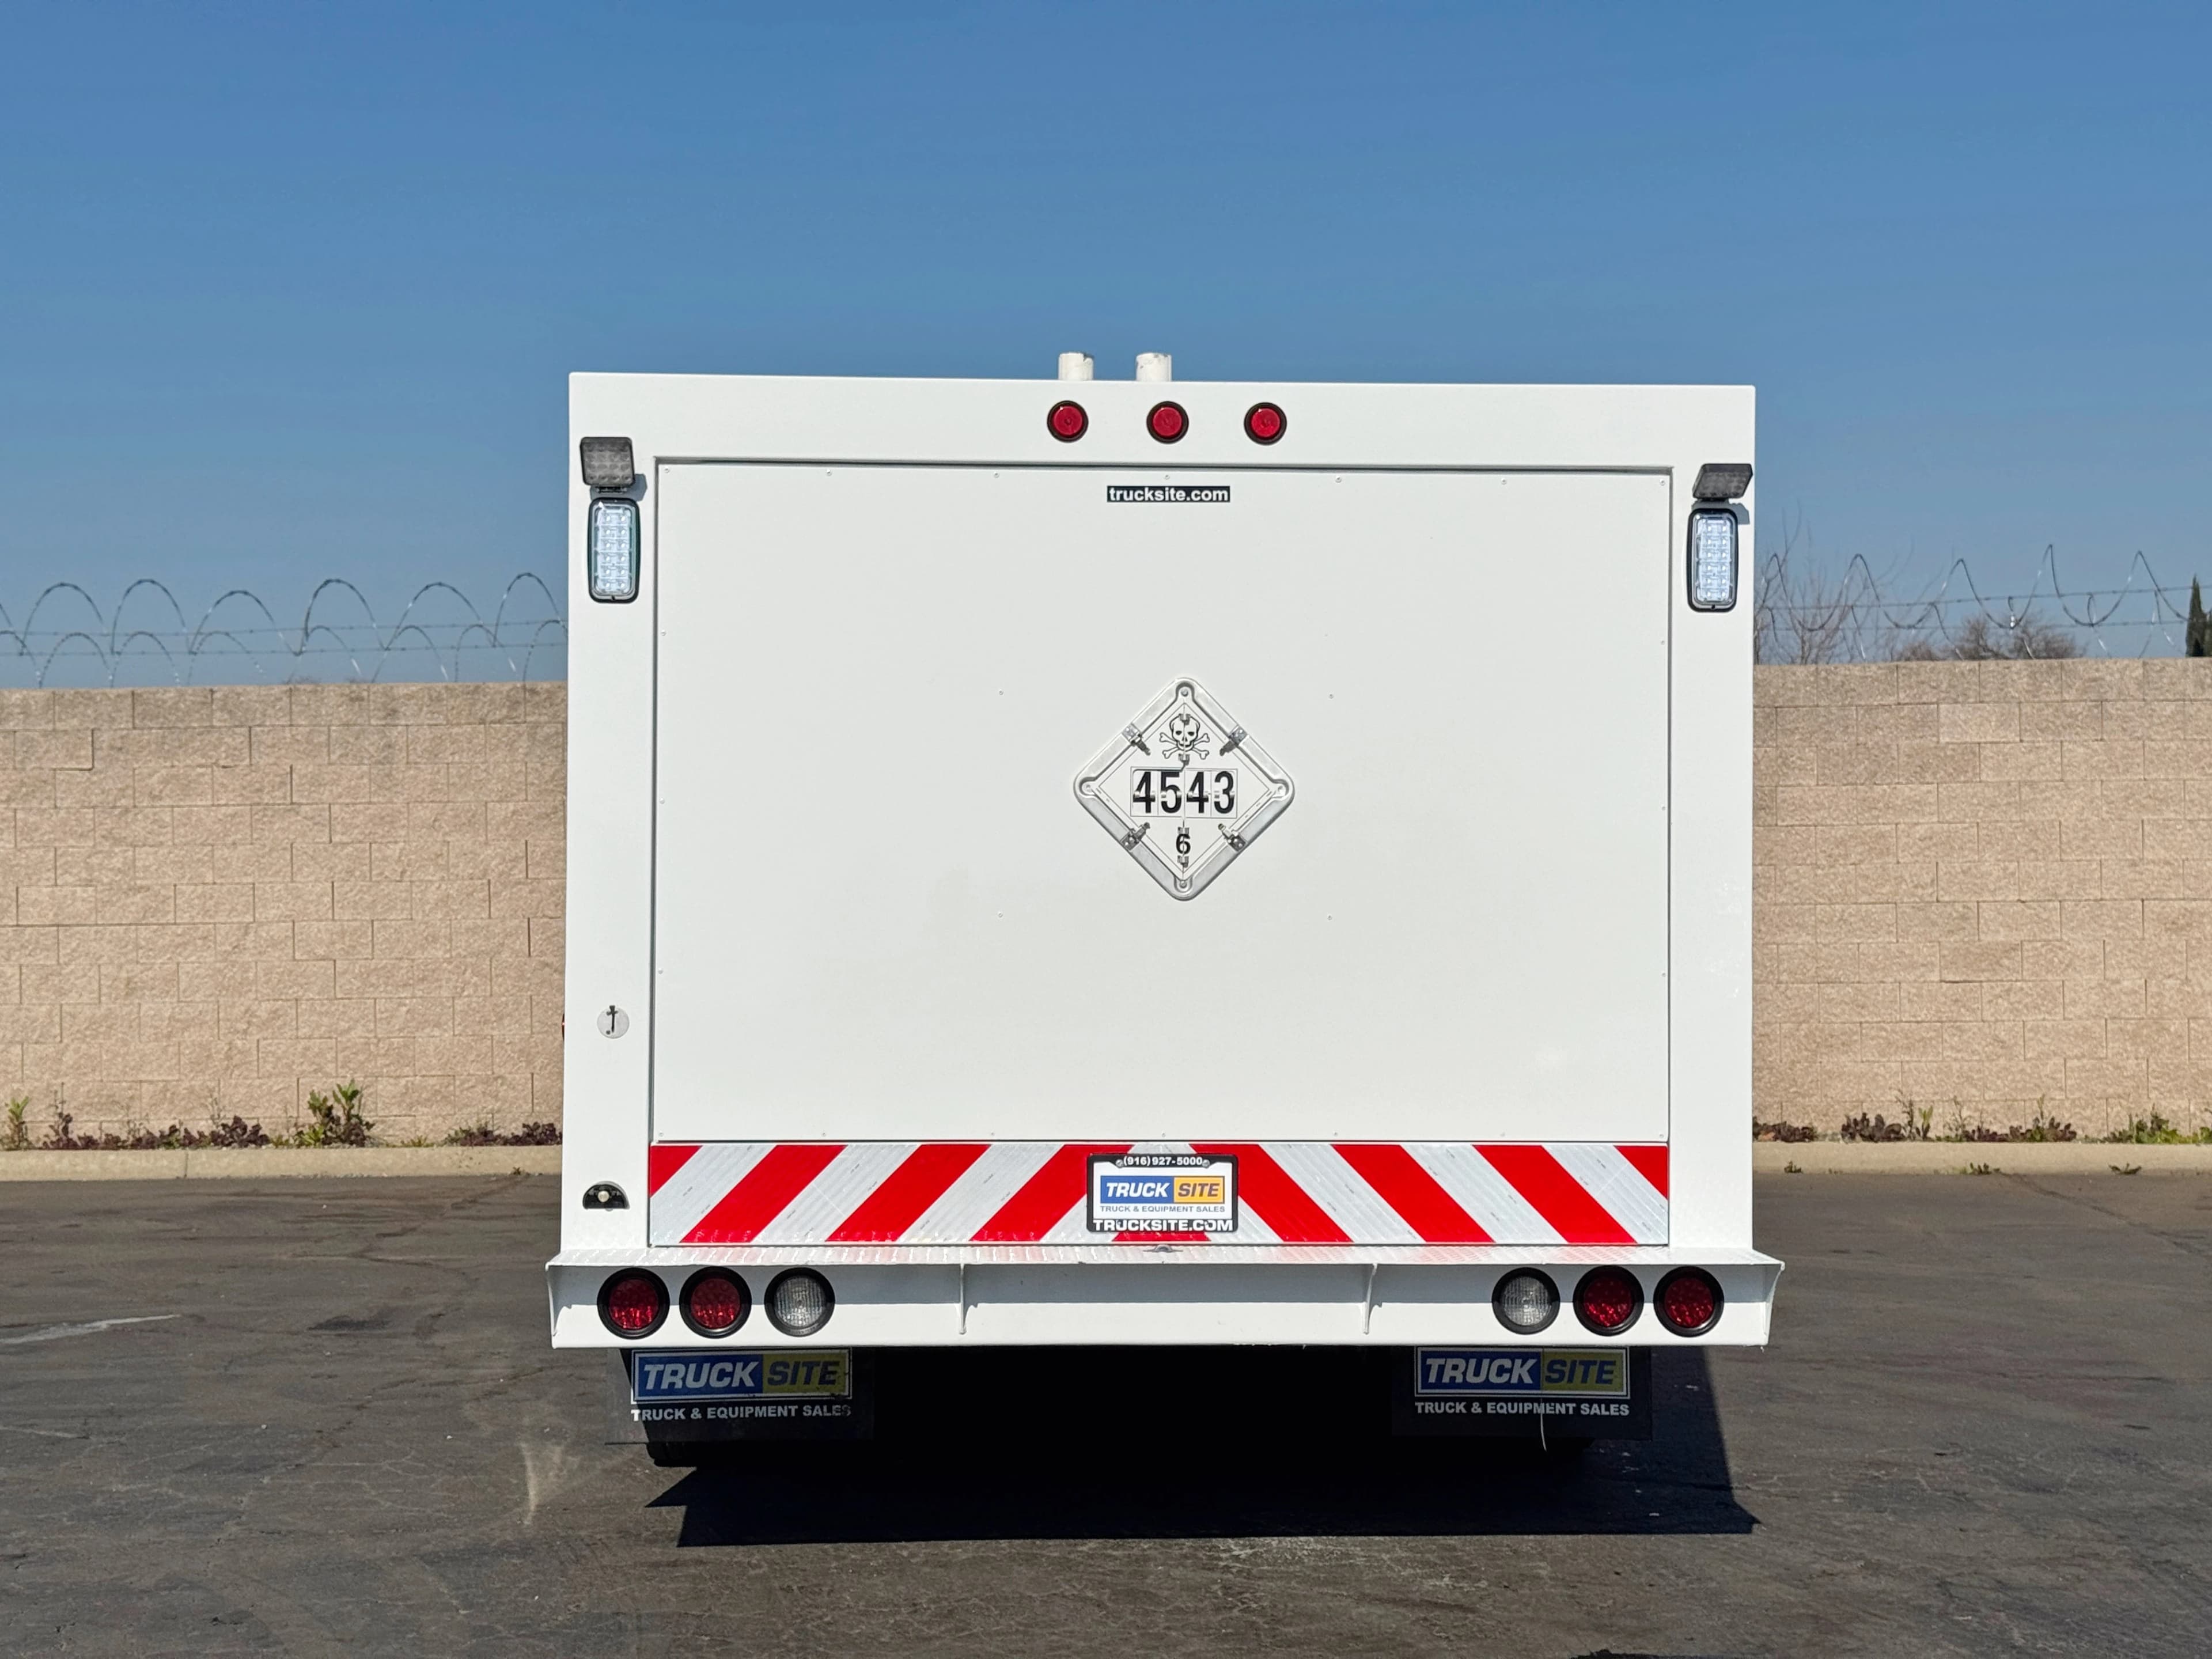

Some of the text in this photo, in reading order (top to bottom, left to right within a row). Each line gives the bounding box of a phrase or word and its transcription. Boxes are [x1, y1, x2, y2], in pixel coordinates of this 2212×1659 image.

[1109, 487, 1228, 501] trucksite.com
[1132, 771, 1234, 814] 4543
[1176, 834, 1191, 854] 6
[1123, 1156, 1203, 1166] (916) 927-5000
[1106, 1182, 1220, 1198] TRUCK SITE
[1093, 1219, 1233, 1231] TRUCKSITE.COM
[643, 1360, 840, 1390] TRUCK SITE
[1425, 1358, 1616, 1384] TRUCK SITE
[631, 1404, 851, 1422] TRUCK & EQUIPMENT SALES
[1414, 1402, 1630, 1416] TRUCK & EQUIPMENT SALES
